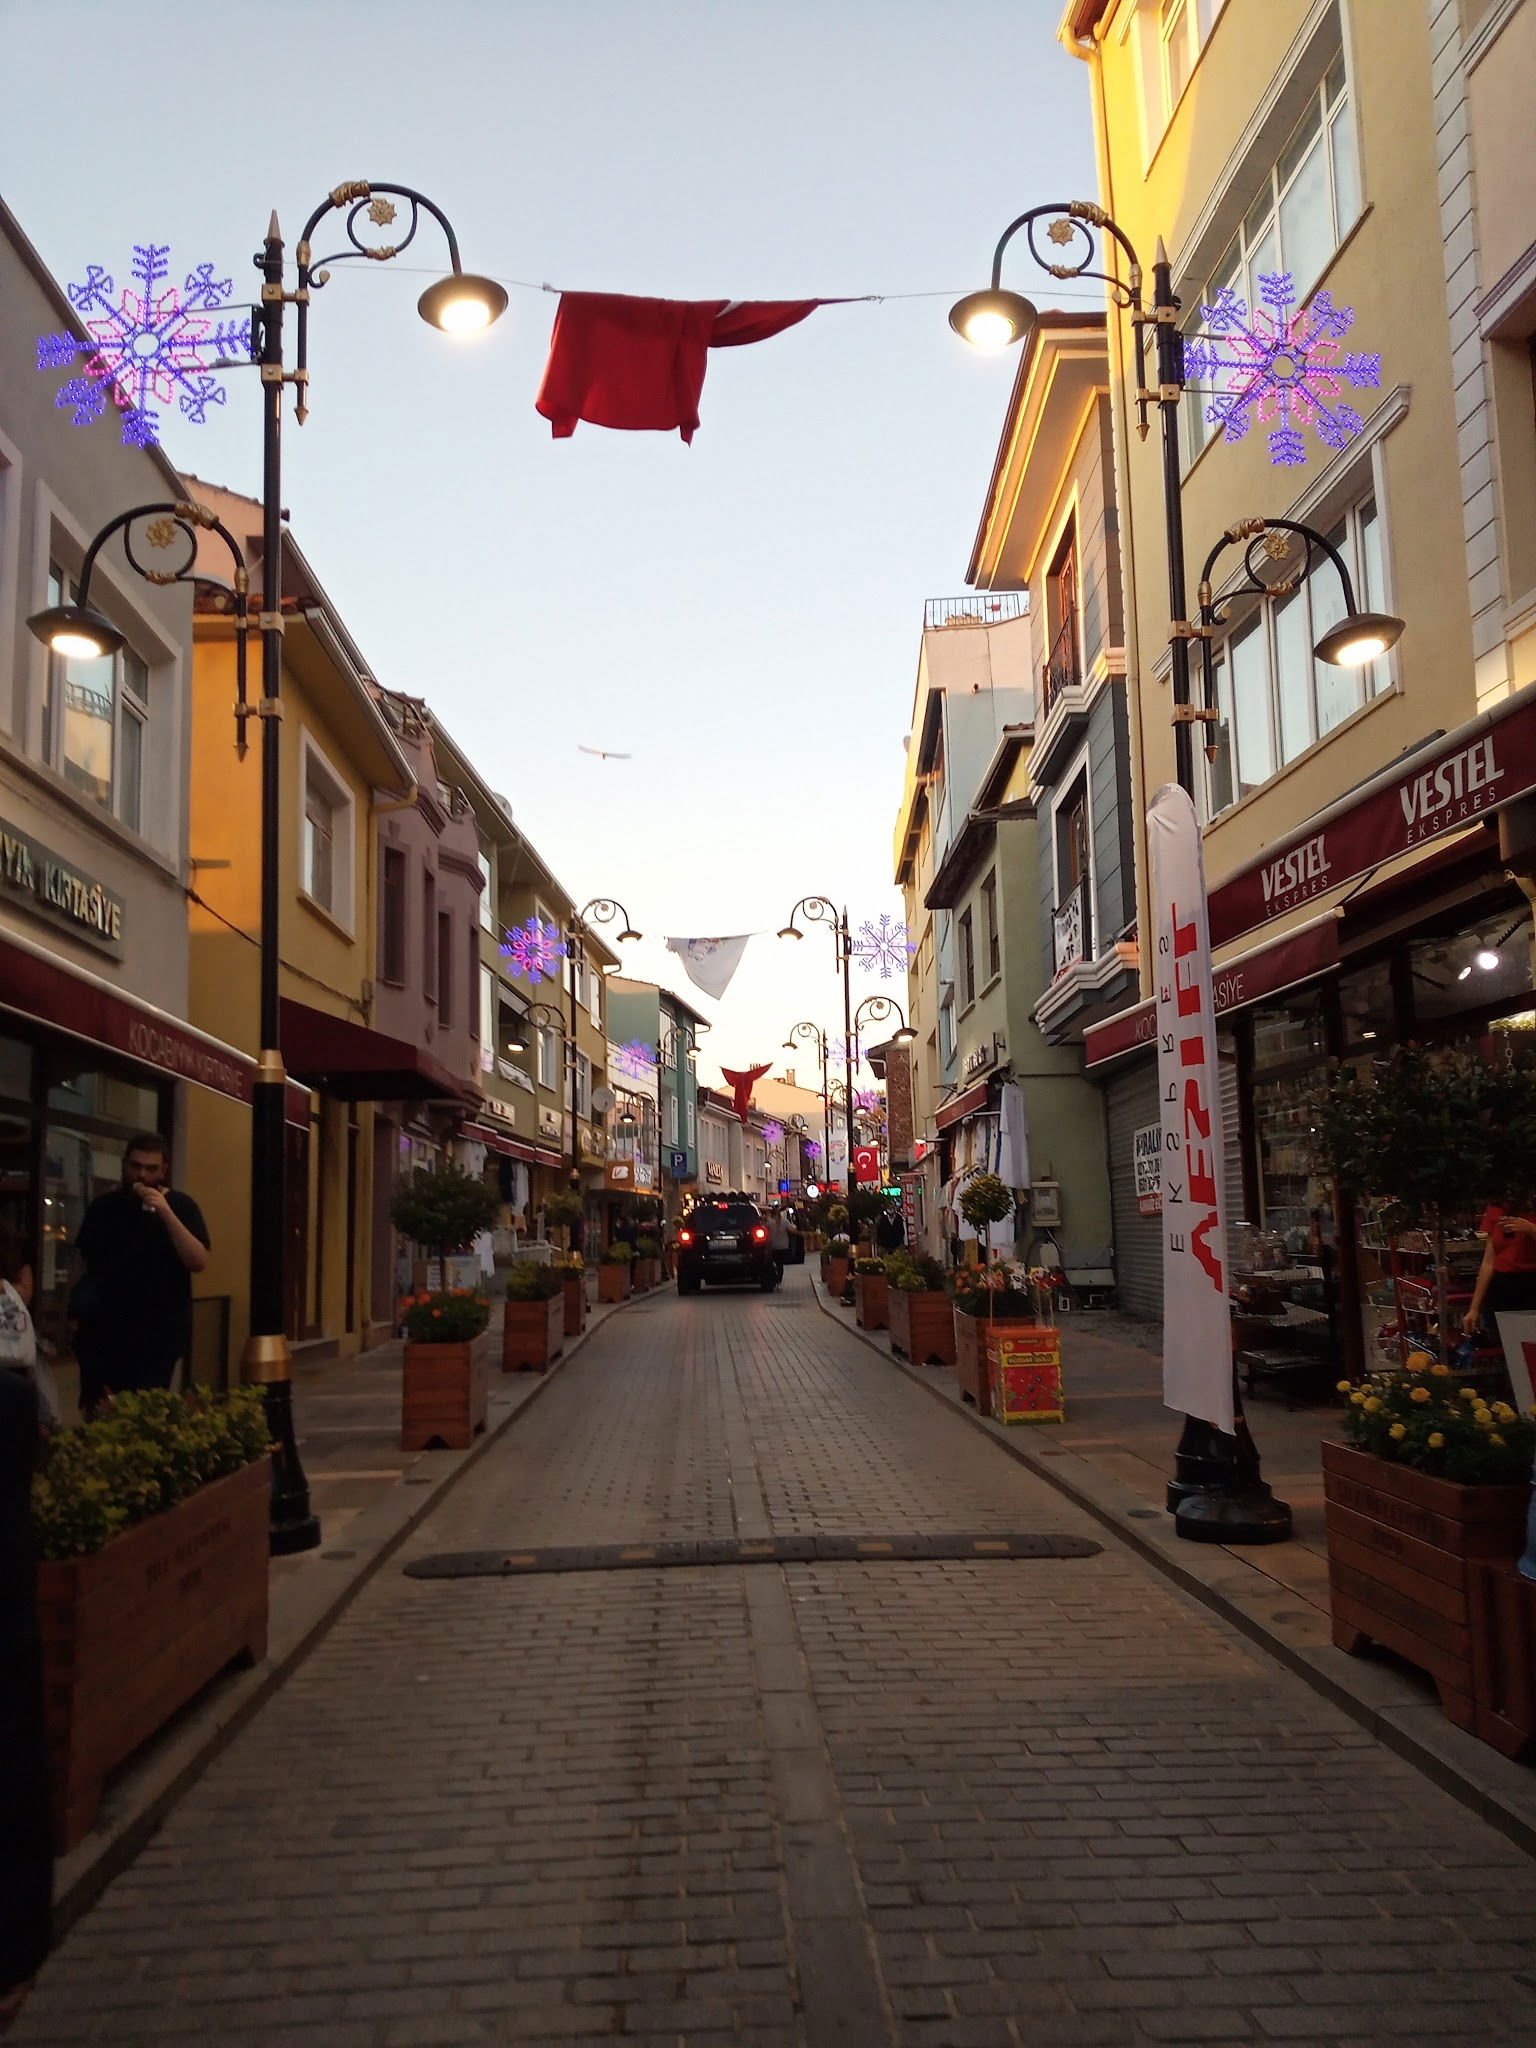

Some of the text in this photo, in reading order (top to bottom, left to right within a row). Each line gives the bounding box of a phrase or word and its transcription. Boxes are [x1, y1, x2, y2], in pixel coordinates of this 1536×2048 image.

[1400, 735, 1504, 825] VESTEL
[1407, 787, 1496, 843] EKSPRES
[1261, 834, 1331, 901] VESTEL
[1266, 875, 1328, 916] EKSPRES
[674, 1154, 683, 1167] P
